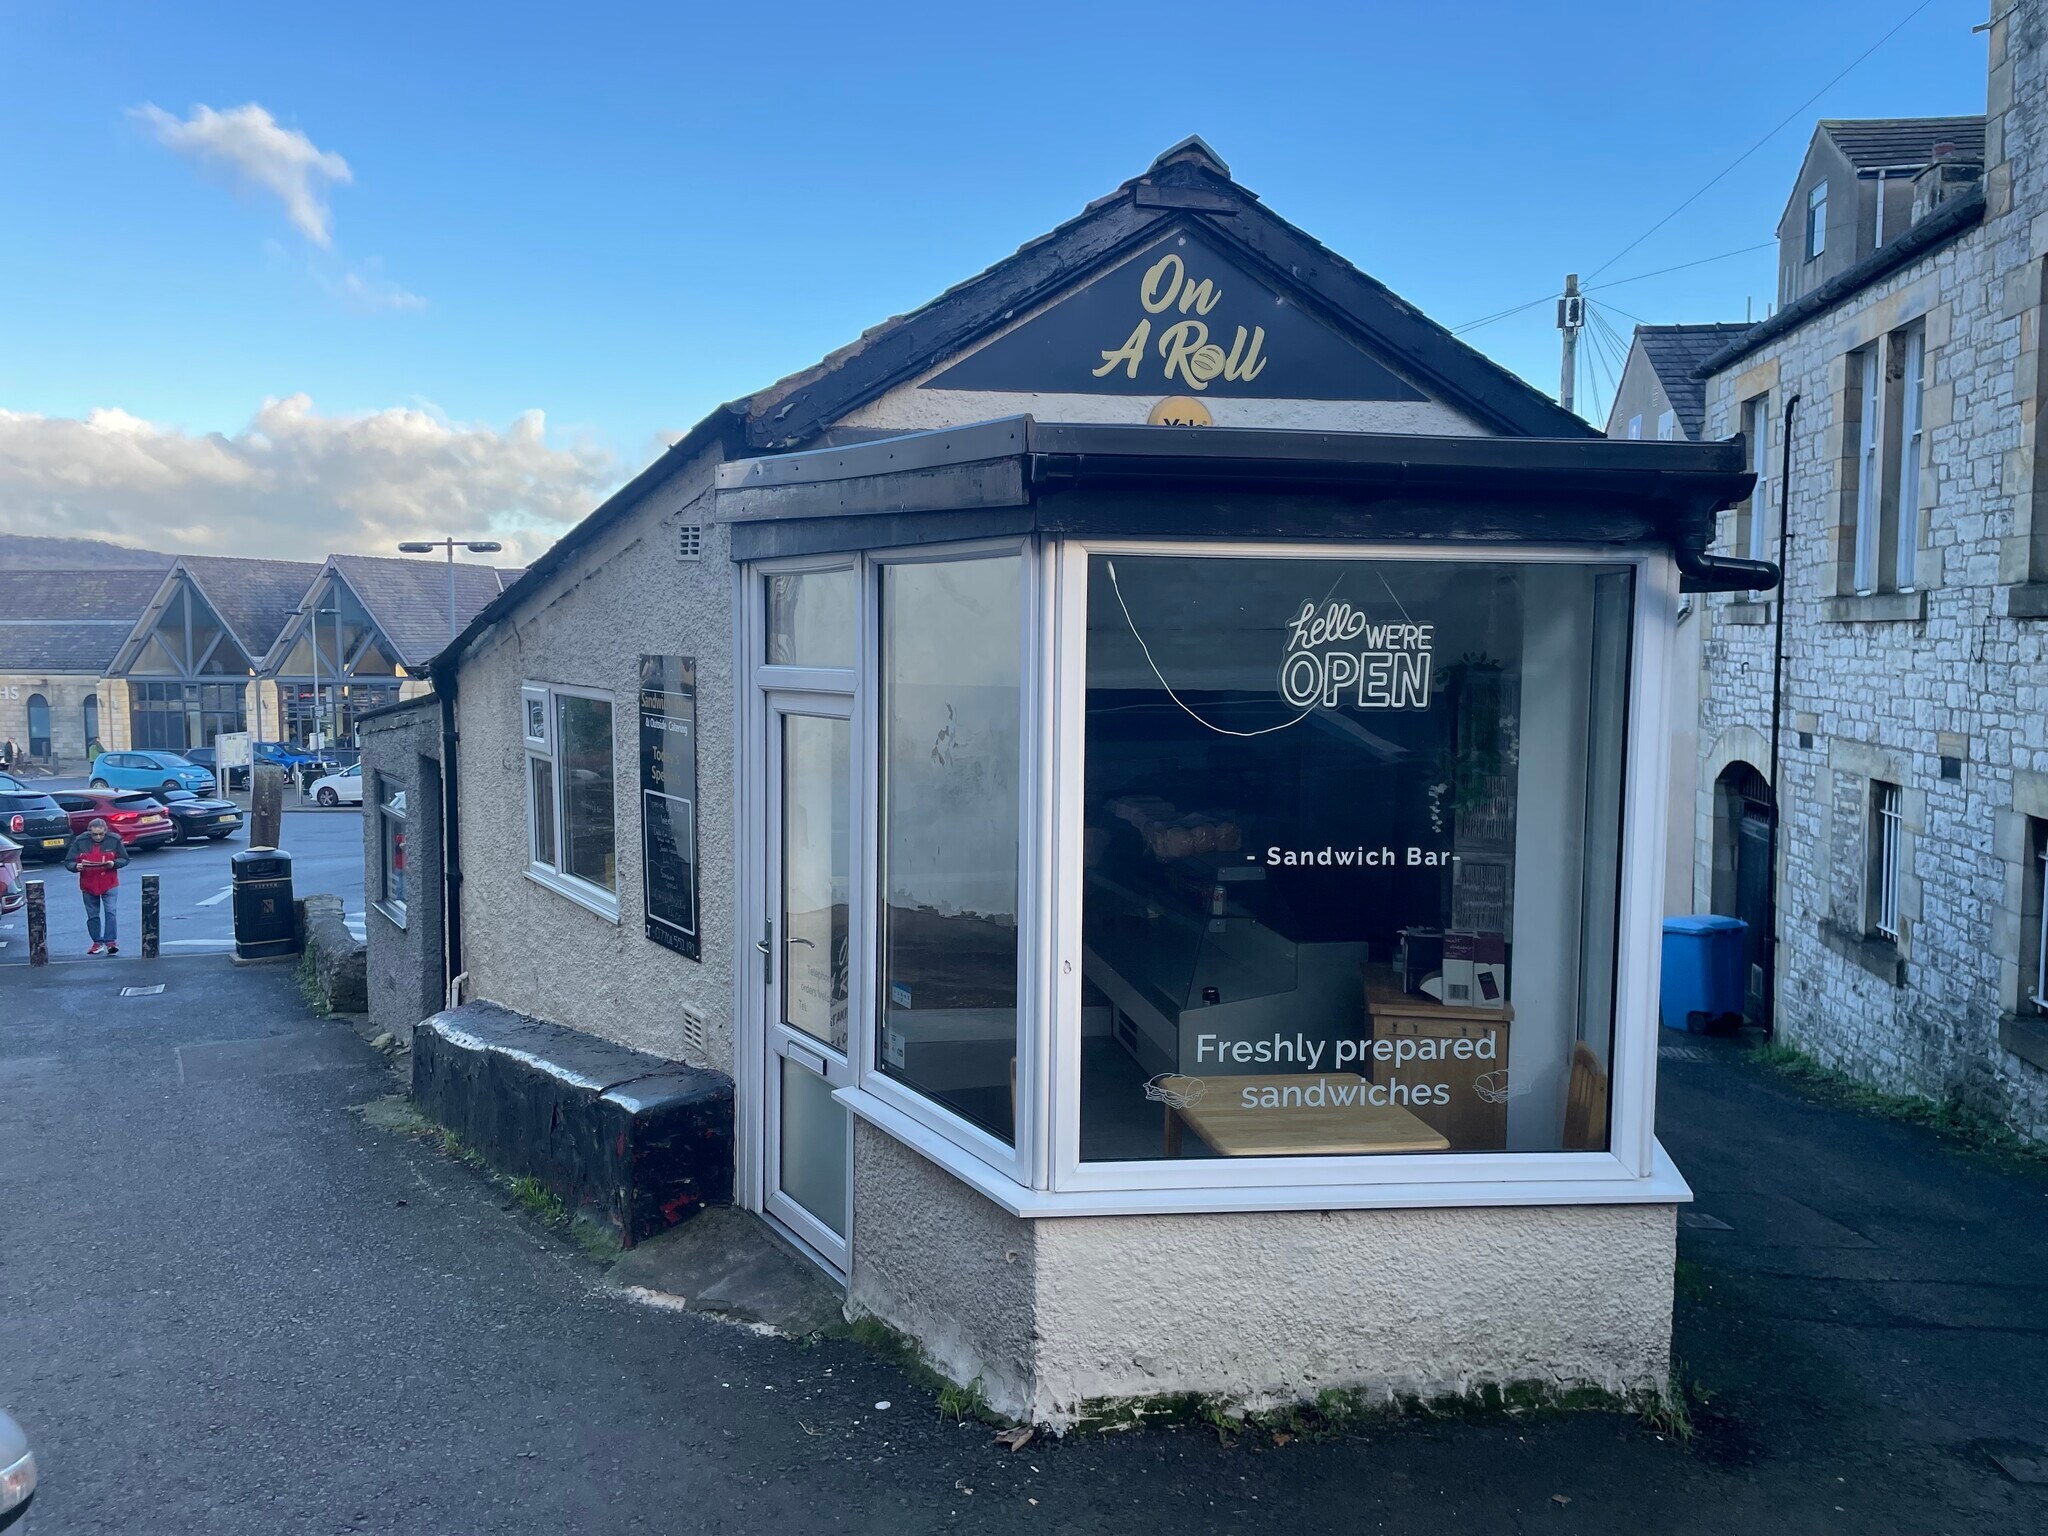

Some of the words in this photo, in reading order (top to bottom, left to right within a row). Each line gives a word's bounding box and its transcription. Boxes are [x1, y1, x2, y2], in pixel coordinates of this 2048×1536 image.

[1141, 253, 1222, 315] On
[1092, 318, 1152, 379] A
[1158, 319, 1267, 390] Roll
[1287, 602, 1366, 652] hello
[1366, 624, 1434, 650] WE'RE
[1281, 651, 1431, 708] OPEN
[650, 718, 667, 730] Outside
[668, 721, 688, 737] Catering
[1266, 846, 1396, 866] Sandwich
[1196, 1032, 1326, 1070] Freshly
[1335, 1031, 1497, 1069] prepared
[1241, 1077, 1451, 1109] sandwiches
